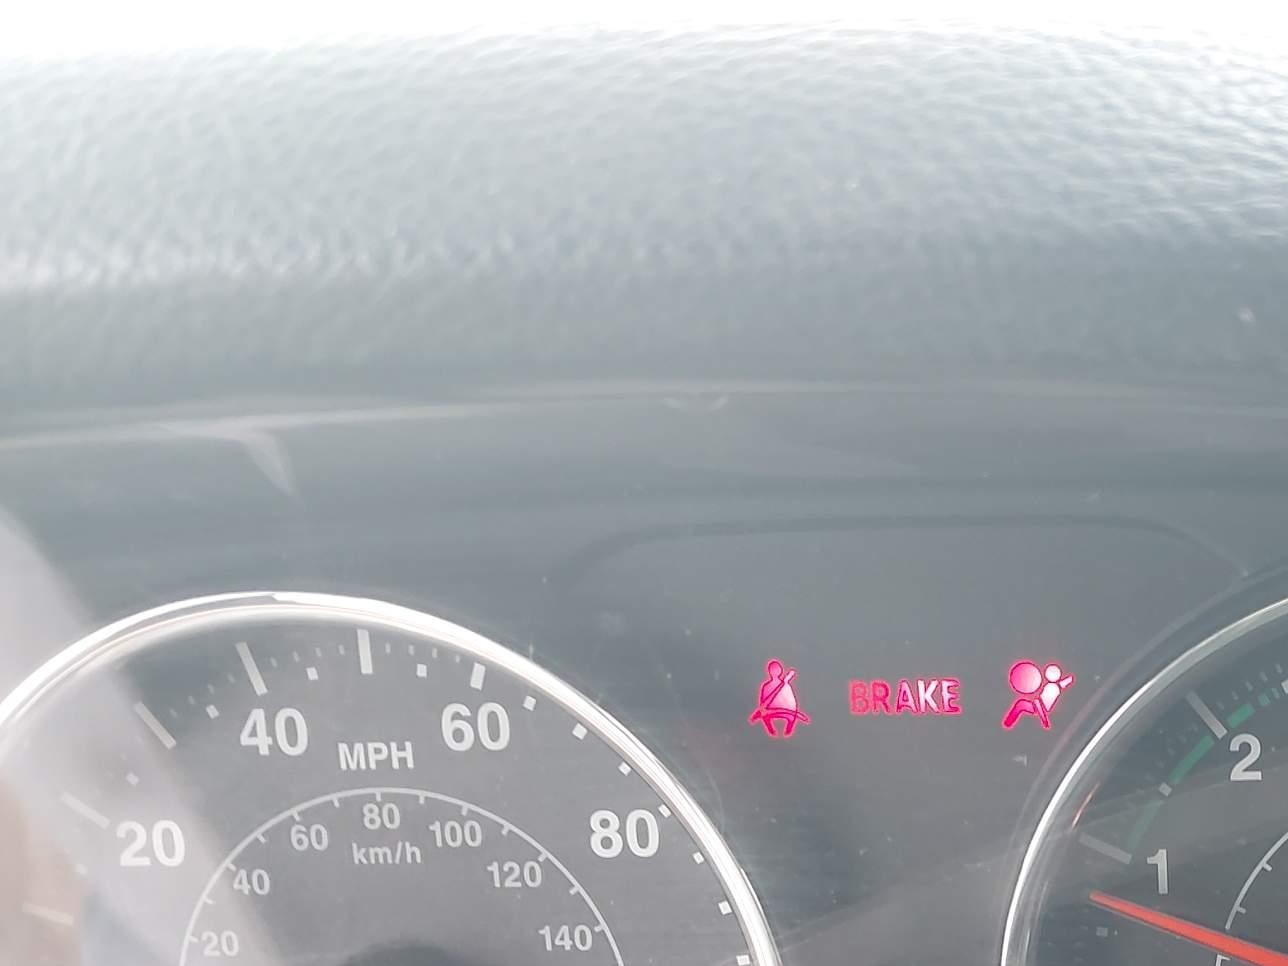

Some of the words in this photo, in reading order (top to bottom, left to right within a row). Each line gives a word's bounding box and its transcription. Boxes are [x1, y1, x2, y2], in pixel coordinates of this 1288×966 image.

[850, 679, 961, 714] BRAKE
[240, 707, 309, 756] 40
[441, 702, 510, 751] 60
[338, 741, 415, 770] MPH
[1230, 734, 1262, 780] 2
[363, 803, 400, 831] 80
[117, 820, 185, 867] 20
[290, 823, 328, 852] 60
[429, 820, 483, 849] 100
[589, 810, 660, 858] 80
[352, 841, 422, 866] km/h
[232, 868, 271, 896] 40
[487, 860, 542, 889] 120
[1147, 849, 1169, 895] 1
[202, 930, 240, 958] 20
[539, 926, 593, 953] 140
